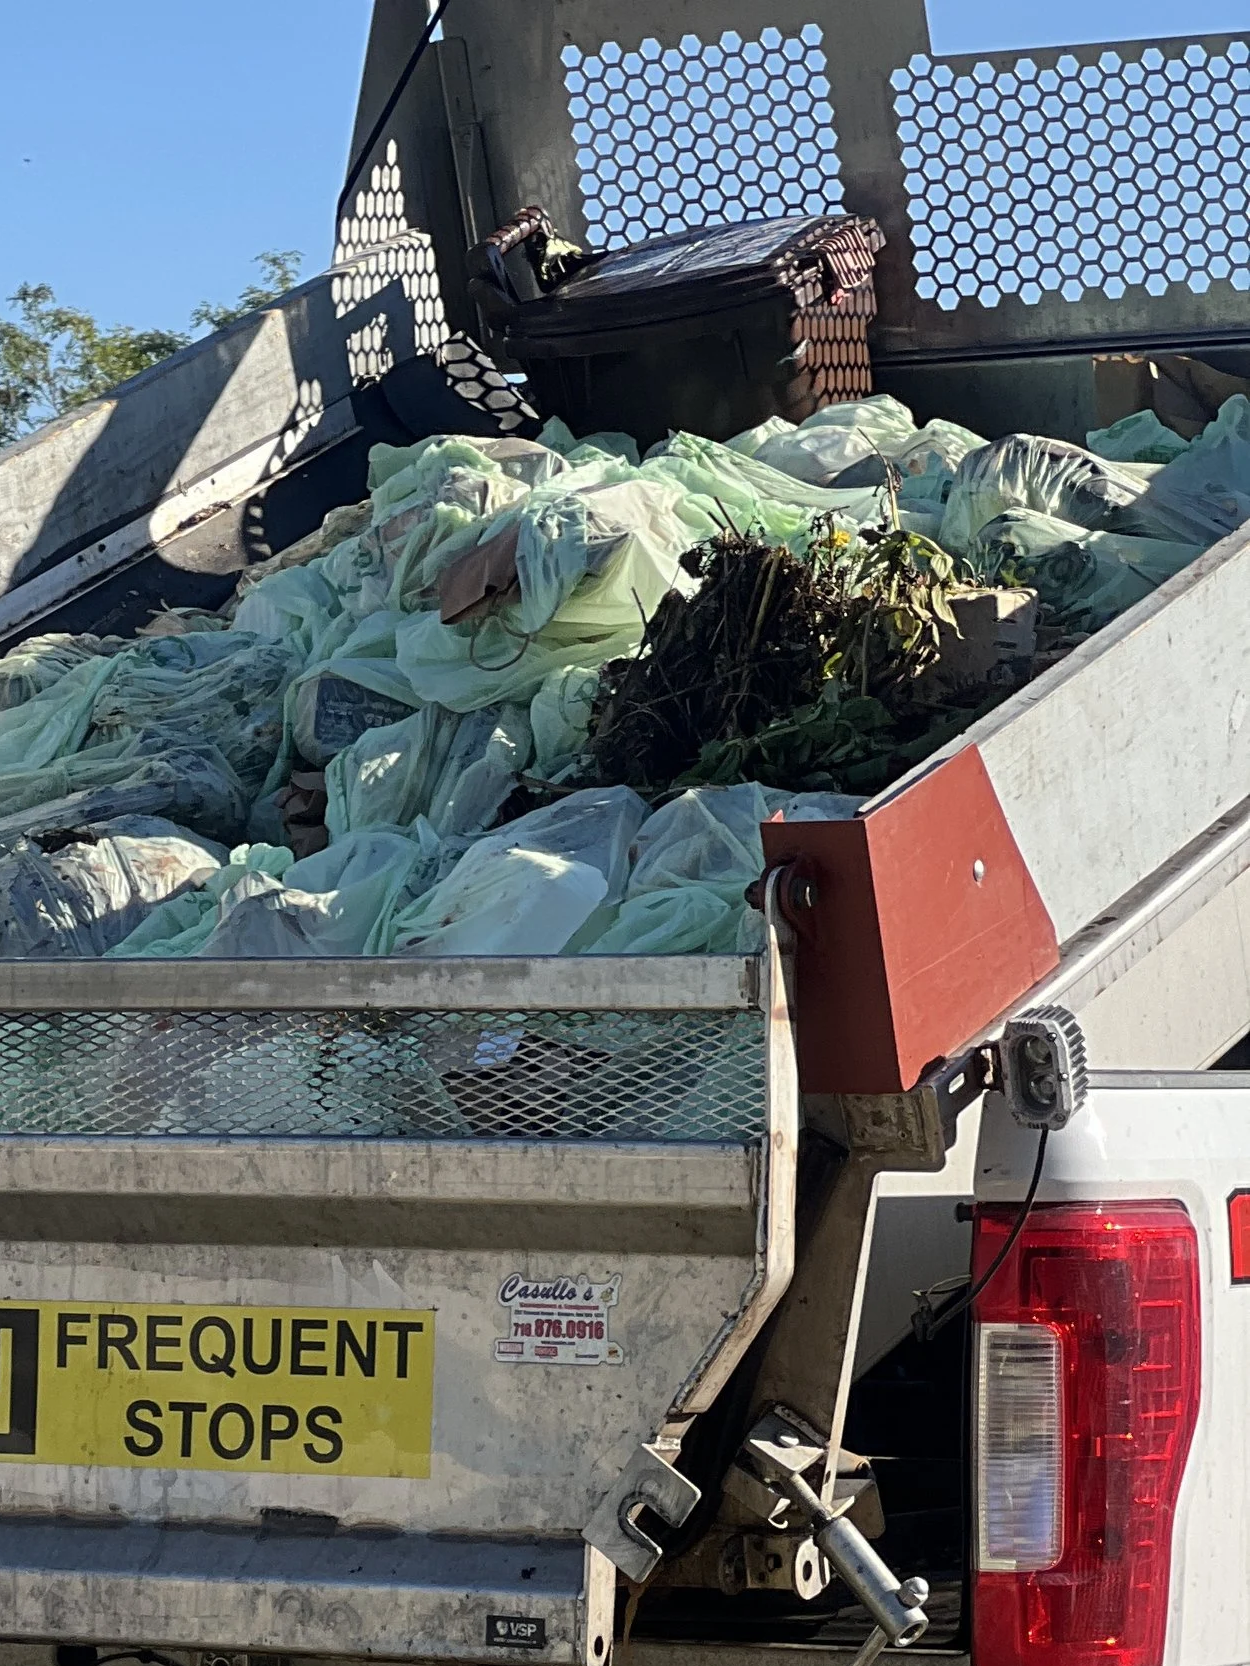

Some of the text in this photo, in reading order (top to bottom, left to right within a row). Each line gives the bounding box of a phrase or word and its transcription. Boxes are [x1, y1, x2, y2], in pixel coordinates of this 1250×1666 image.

[56, 1312, 423, 1380] FREQUENT
[124, 1399, 344, 1465] STOPS
[510, 1622, 537, 1637] VSP
